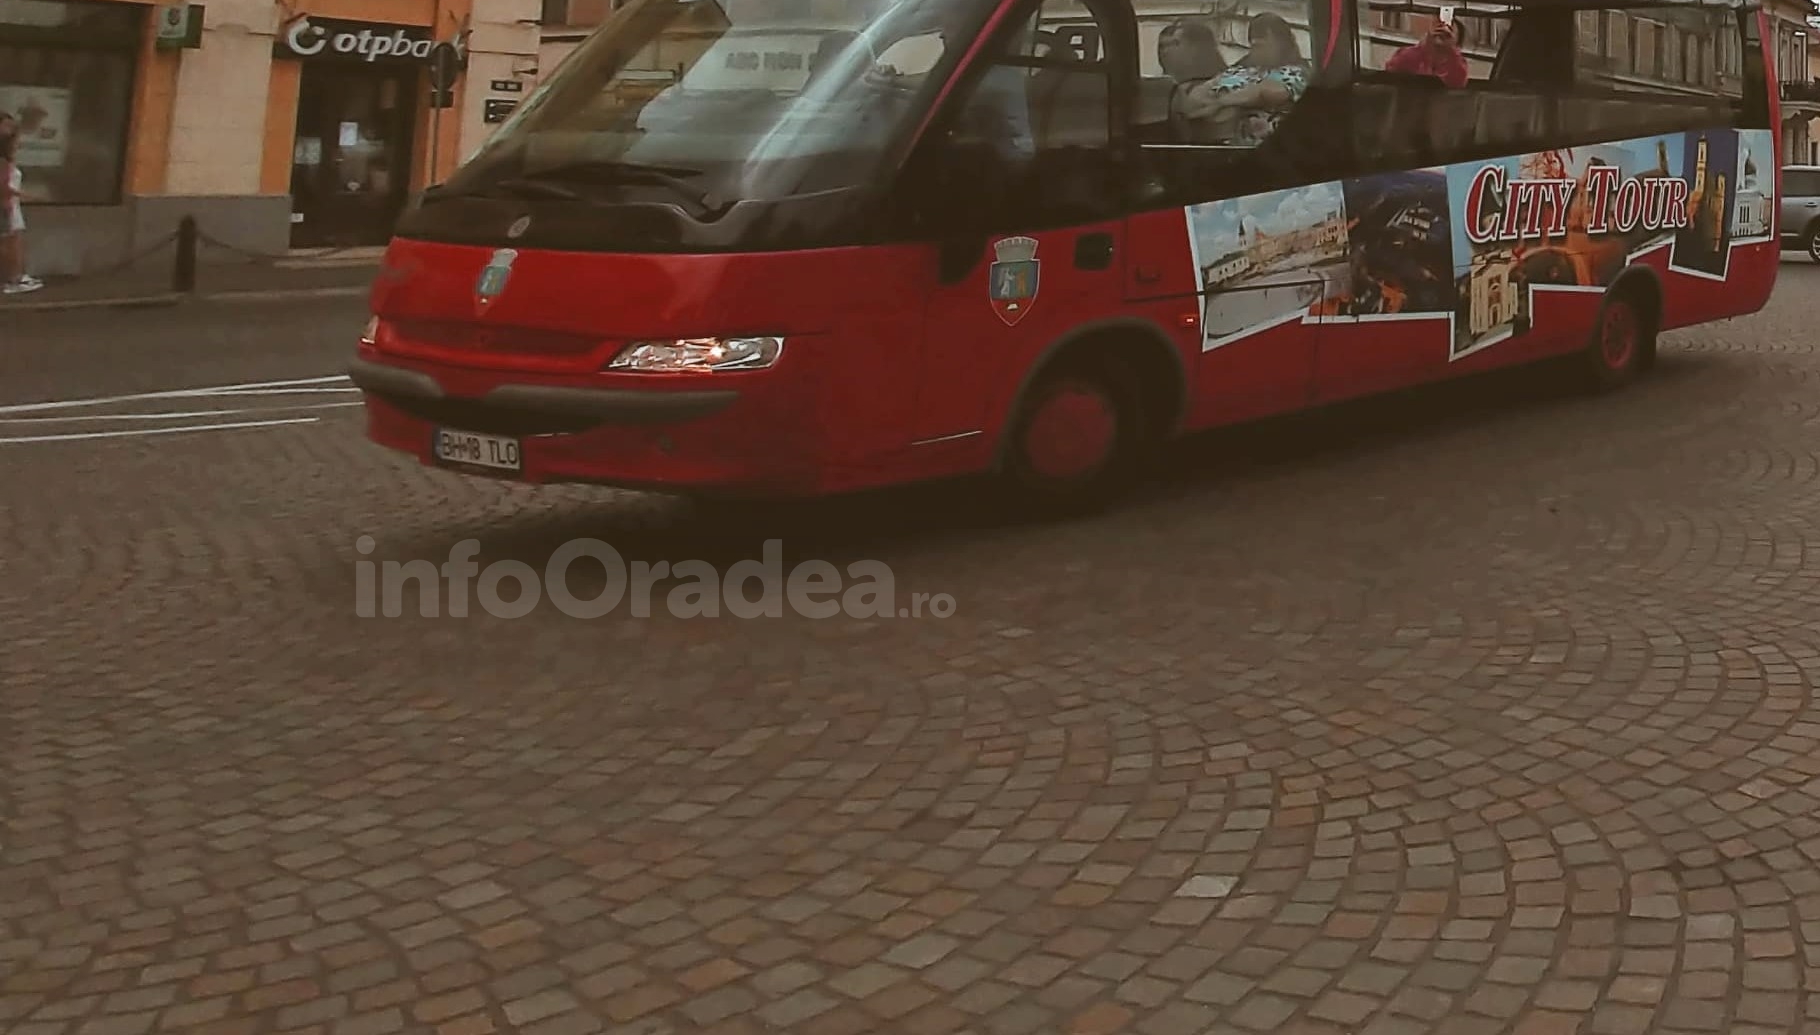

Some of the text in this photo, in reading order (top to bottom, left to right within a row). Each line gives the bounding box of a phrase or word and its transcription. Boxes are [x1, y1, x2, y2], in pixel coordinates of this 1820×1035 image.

[334, 29, 465, 62] otpbak
[1464, 165, 1688, 244] CITY TOUR
